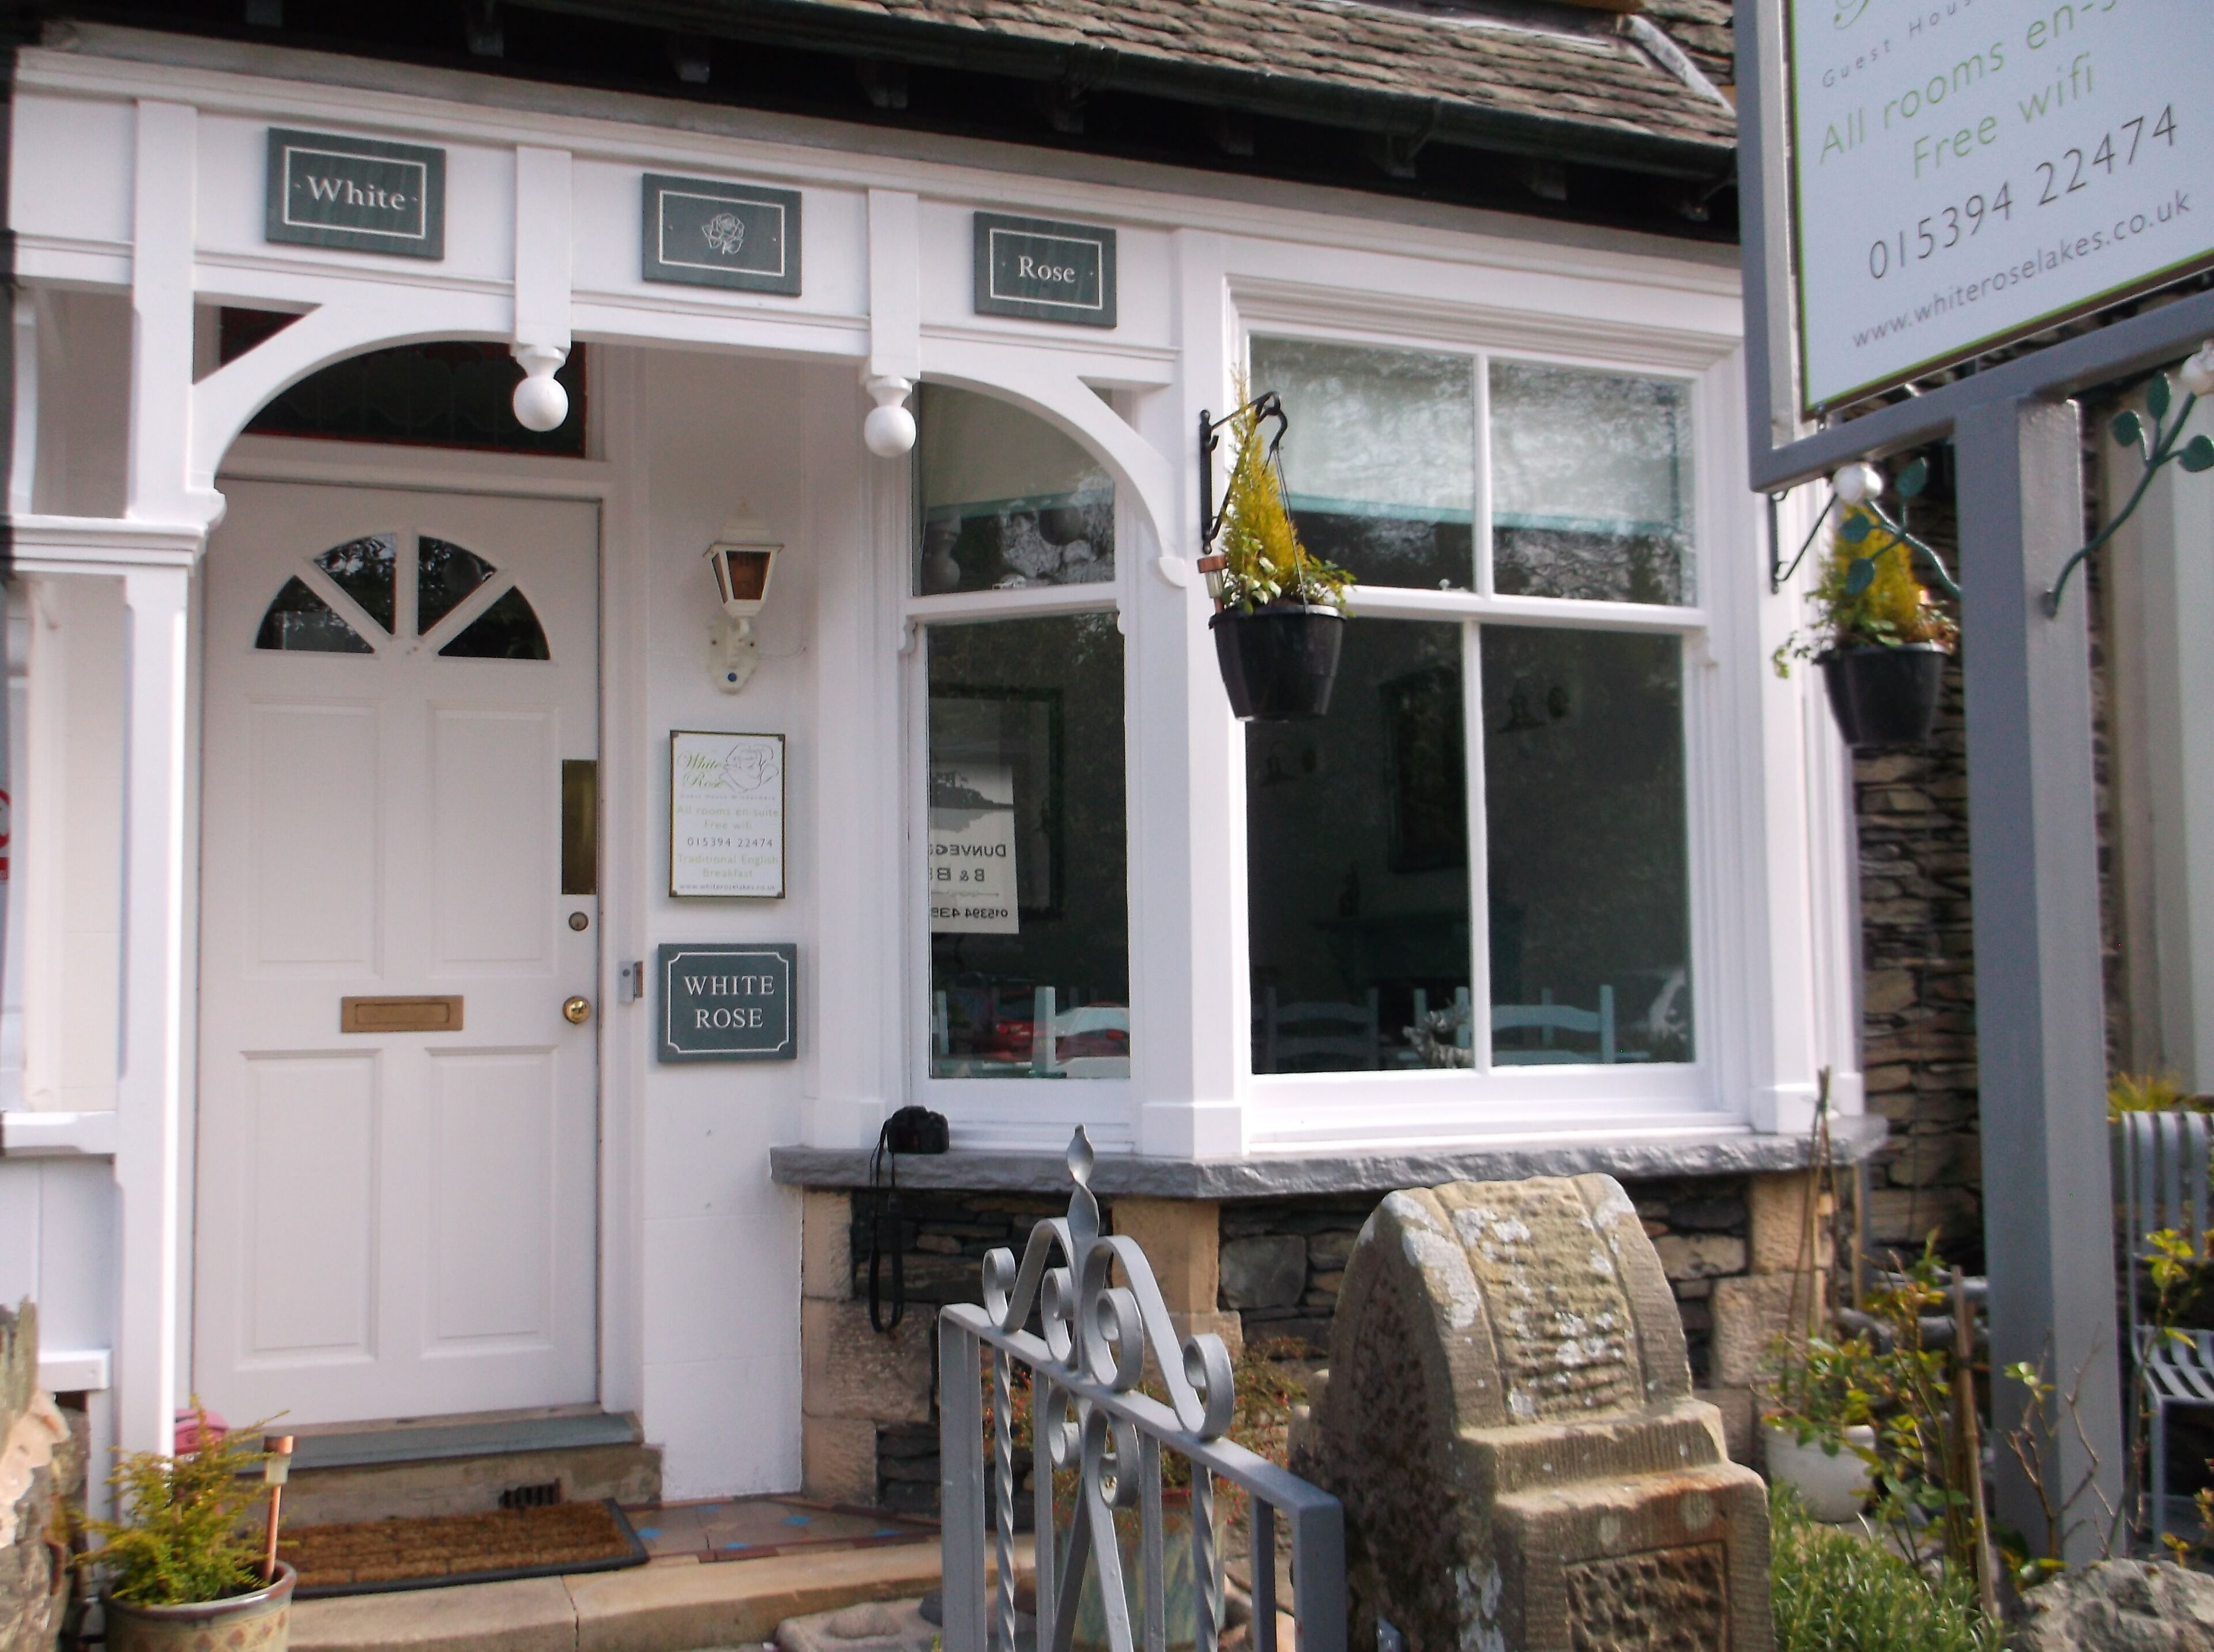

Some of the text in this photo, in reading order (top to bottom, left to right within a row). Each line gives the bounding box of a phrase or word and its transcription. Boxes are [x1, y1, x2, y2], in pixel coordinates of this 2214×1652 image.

[1822, 39, 1892, 88] Guest
[1821, 108, 1866, 164] All
[1883, 42, 2005, 129] rooms
[1913, 51, 2095, 179] Free wifi
[306, 174, 406, 213] White
[1869, 104, 2178, 281] 015394 22474
[1018, 255, 1075, 285] Rose
[1852, 190, 2191, 349] www.whiteroselakes.co.uk
[677, 752, 722, 770] White
[696, 807, 730, 816] rooms
[704, 820, 729, 829] Free
[687, 836, 773, 847] 015394 22474
[678, 854, 778, 866] Traditional English
[703, 868, 753, 877] Breakfast
[684, 975, 775, 996] WHITE
[695, 1008, 764, 1029] ROSE
